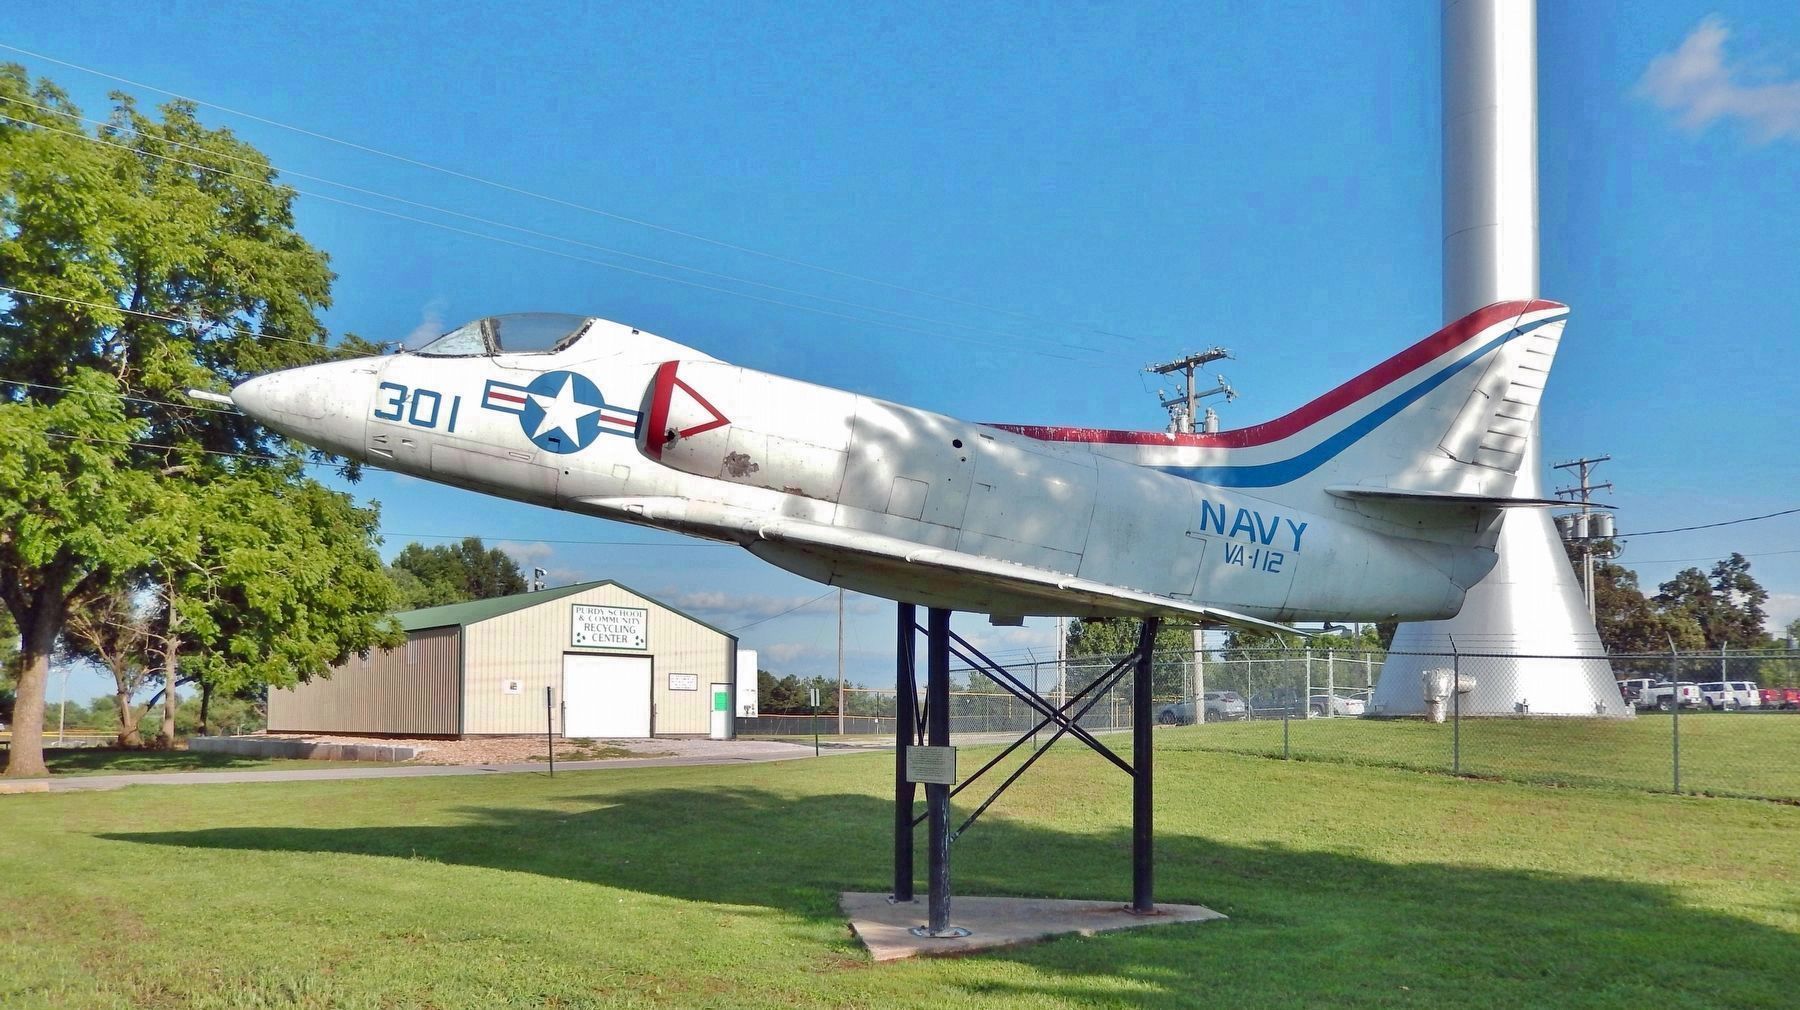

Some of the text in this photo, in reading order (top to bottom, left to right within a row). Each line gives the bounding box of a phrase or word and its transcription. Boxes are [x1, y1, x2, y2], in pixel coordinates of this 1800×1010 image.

[374, 381, 461, 433] 301
[1200, 499, 1308, 552] NAVY
[576, 607, 643, 618] PURDY SCHOOL
[588, 616, 640, 625] COMMUNITY
[584, 623, 636, 634] RECYCLING
[592, 633, 628, 643] CENTER
